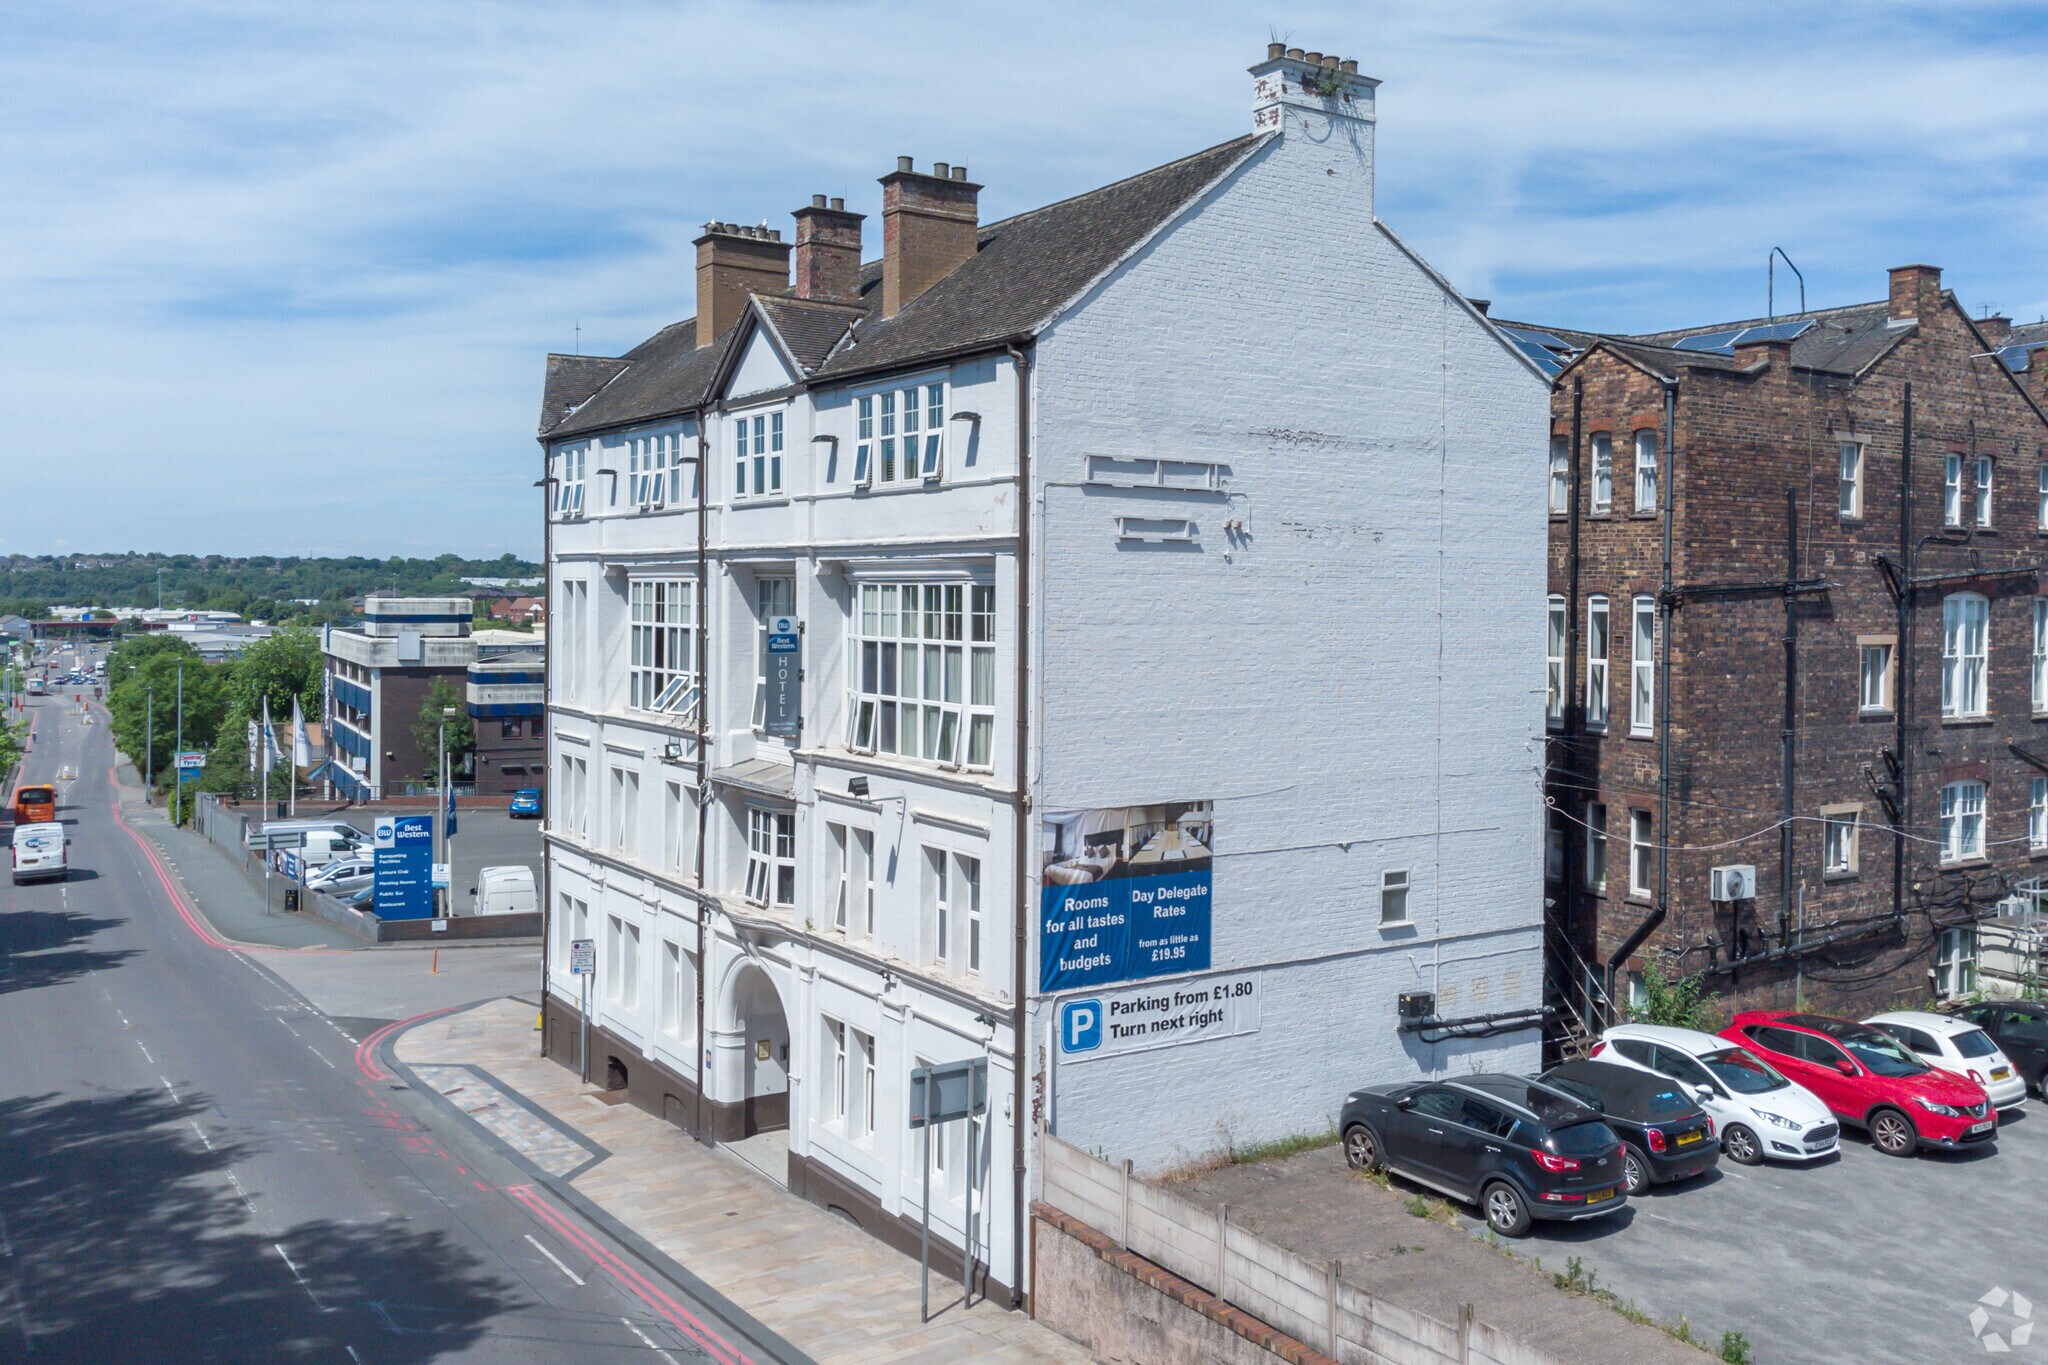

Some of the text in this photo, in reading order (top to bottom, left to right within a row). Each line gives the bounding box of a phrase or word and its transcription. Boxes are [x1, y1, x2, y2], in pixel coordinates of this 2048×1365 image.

[778, 657, 788, 717] HOTEL
[377, 829, 392, 837] BW
[1064, 897, 1109, 911] Rooms
[1132, 884, 1208, 904] Day Delegate
[1153, 905, 1186, 918] Rates
[1045, 913, 1125, 933] for all tastes
[1073, 934, 1098, 949] and
[1138, 939, 1158, 948] from
[1159, 937, 1169, 946] as
[1169, 935, 1188, 944] little
[1060, 952, 1111, 972] budgets
[1151, 946, 1186, 962] £19.95
[1110, 981, 1253, 1016] Parking from £1.80
[1071, 1008, 1094, 1046] P
[1110, 1007, 1223, 1039] Turn next right
